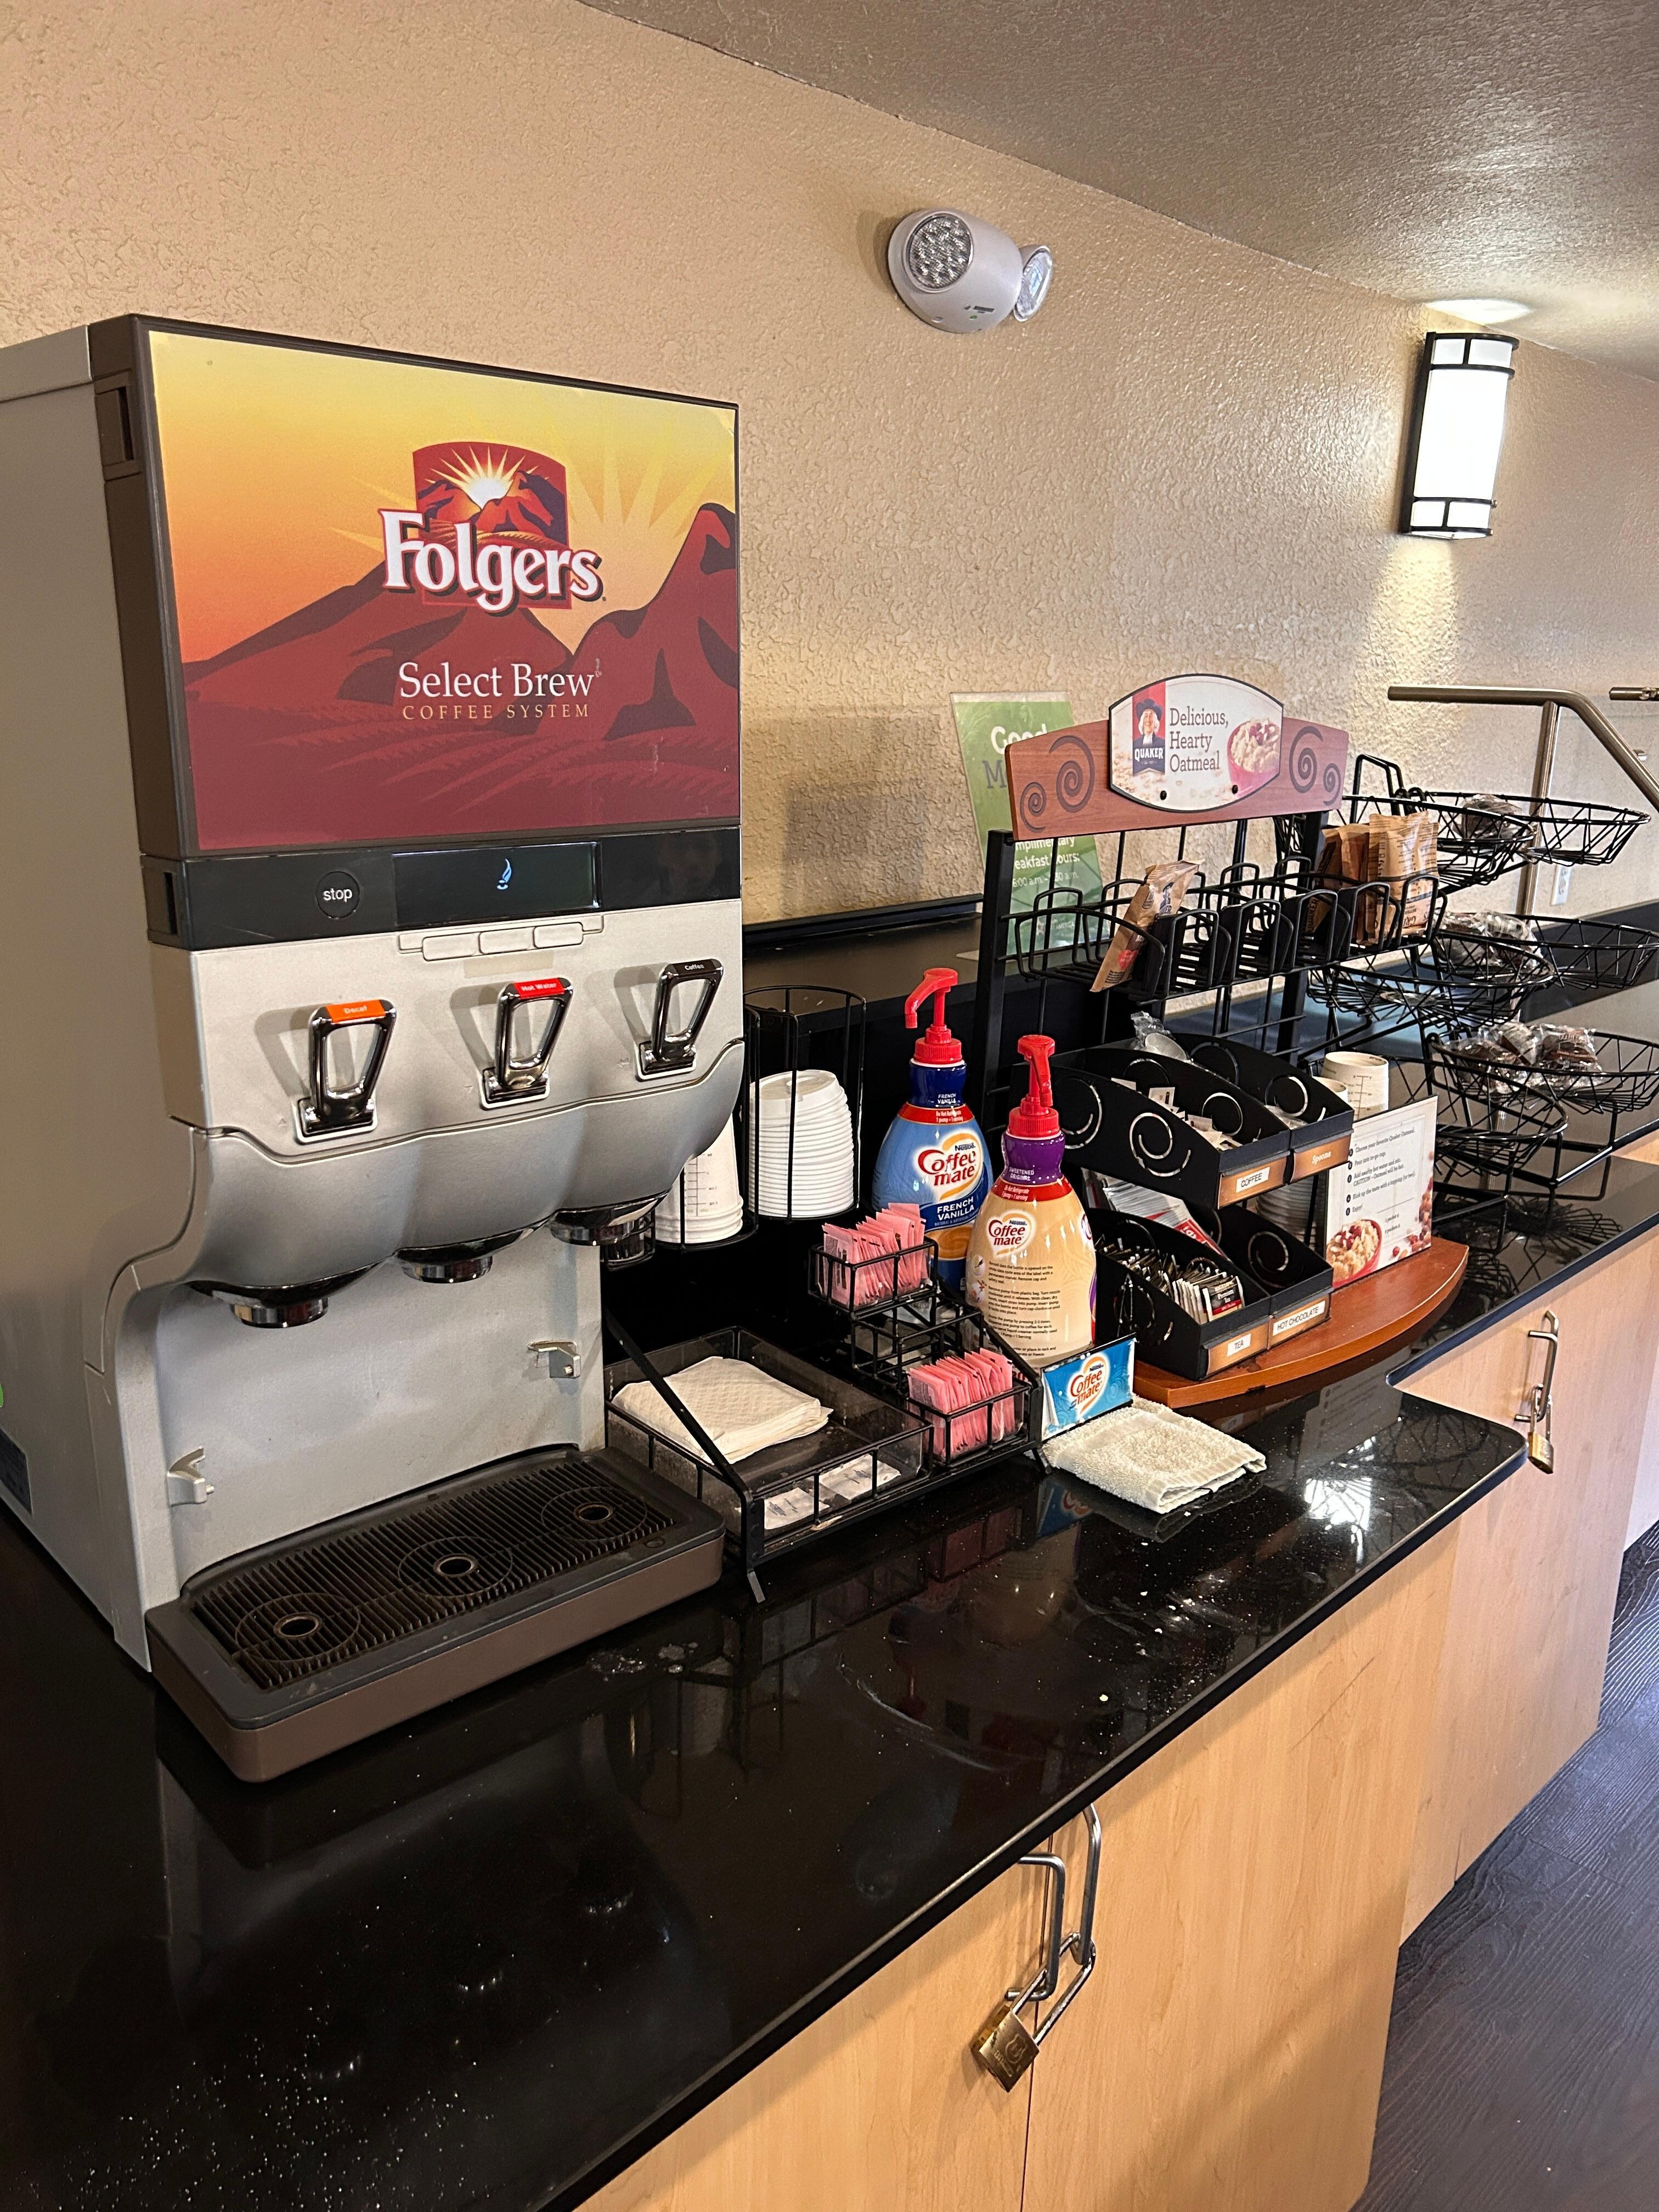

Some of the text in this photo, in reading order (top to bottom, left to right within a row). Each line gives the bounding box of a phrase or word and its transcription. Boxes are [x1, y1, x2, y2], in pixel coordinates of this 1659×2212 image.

[380, 509, 602, 614] Folgers
[399, 662, 594, 697] Select Brew
[403, 704, 589, 720] COFFEE SYSTEM
[1170, 706, 1228, 729] Delicious,
[1170, 731, 1212, 753] Hearty
[1134, 747, 1164, 761] QUAKER
[1170, 750, 1221, 772] Oatmeal
[323, 888, 353, 903] stop
[343, 1005, 368, 1014] Decaf
[1311, 1151, 1331, 1165] Spoons
[934, 1165, 975, 1186] mate
[1240, 1172, 1263, 1188] COFFEE
[937, 1196, 974, 1214] FRENCH
[937, 1205, 975, 1221] VANILLA
[989, 1219, 1025, 1238] Coffee
[994, 1236, 1022, 1246] mate
[1277, 1306, 1319, 1331] HOT CHOCOLATE
[1234, 1339, 1244, 1351] TEA
[1070, 1370, 1103, 1397] Coffee
[1077, 1381, 1101, 1405] mate
